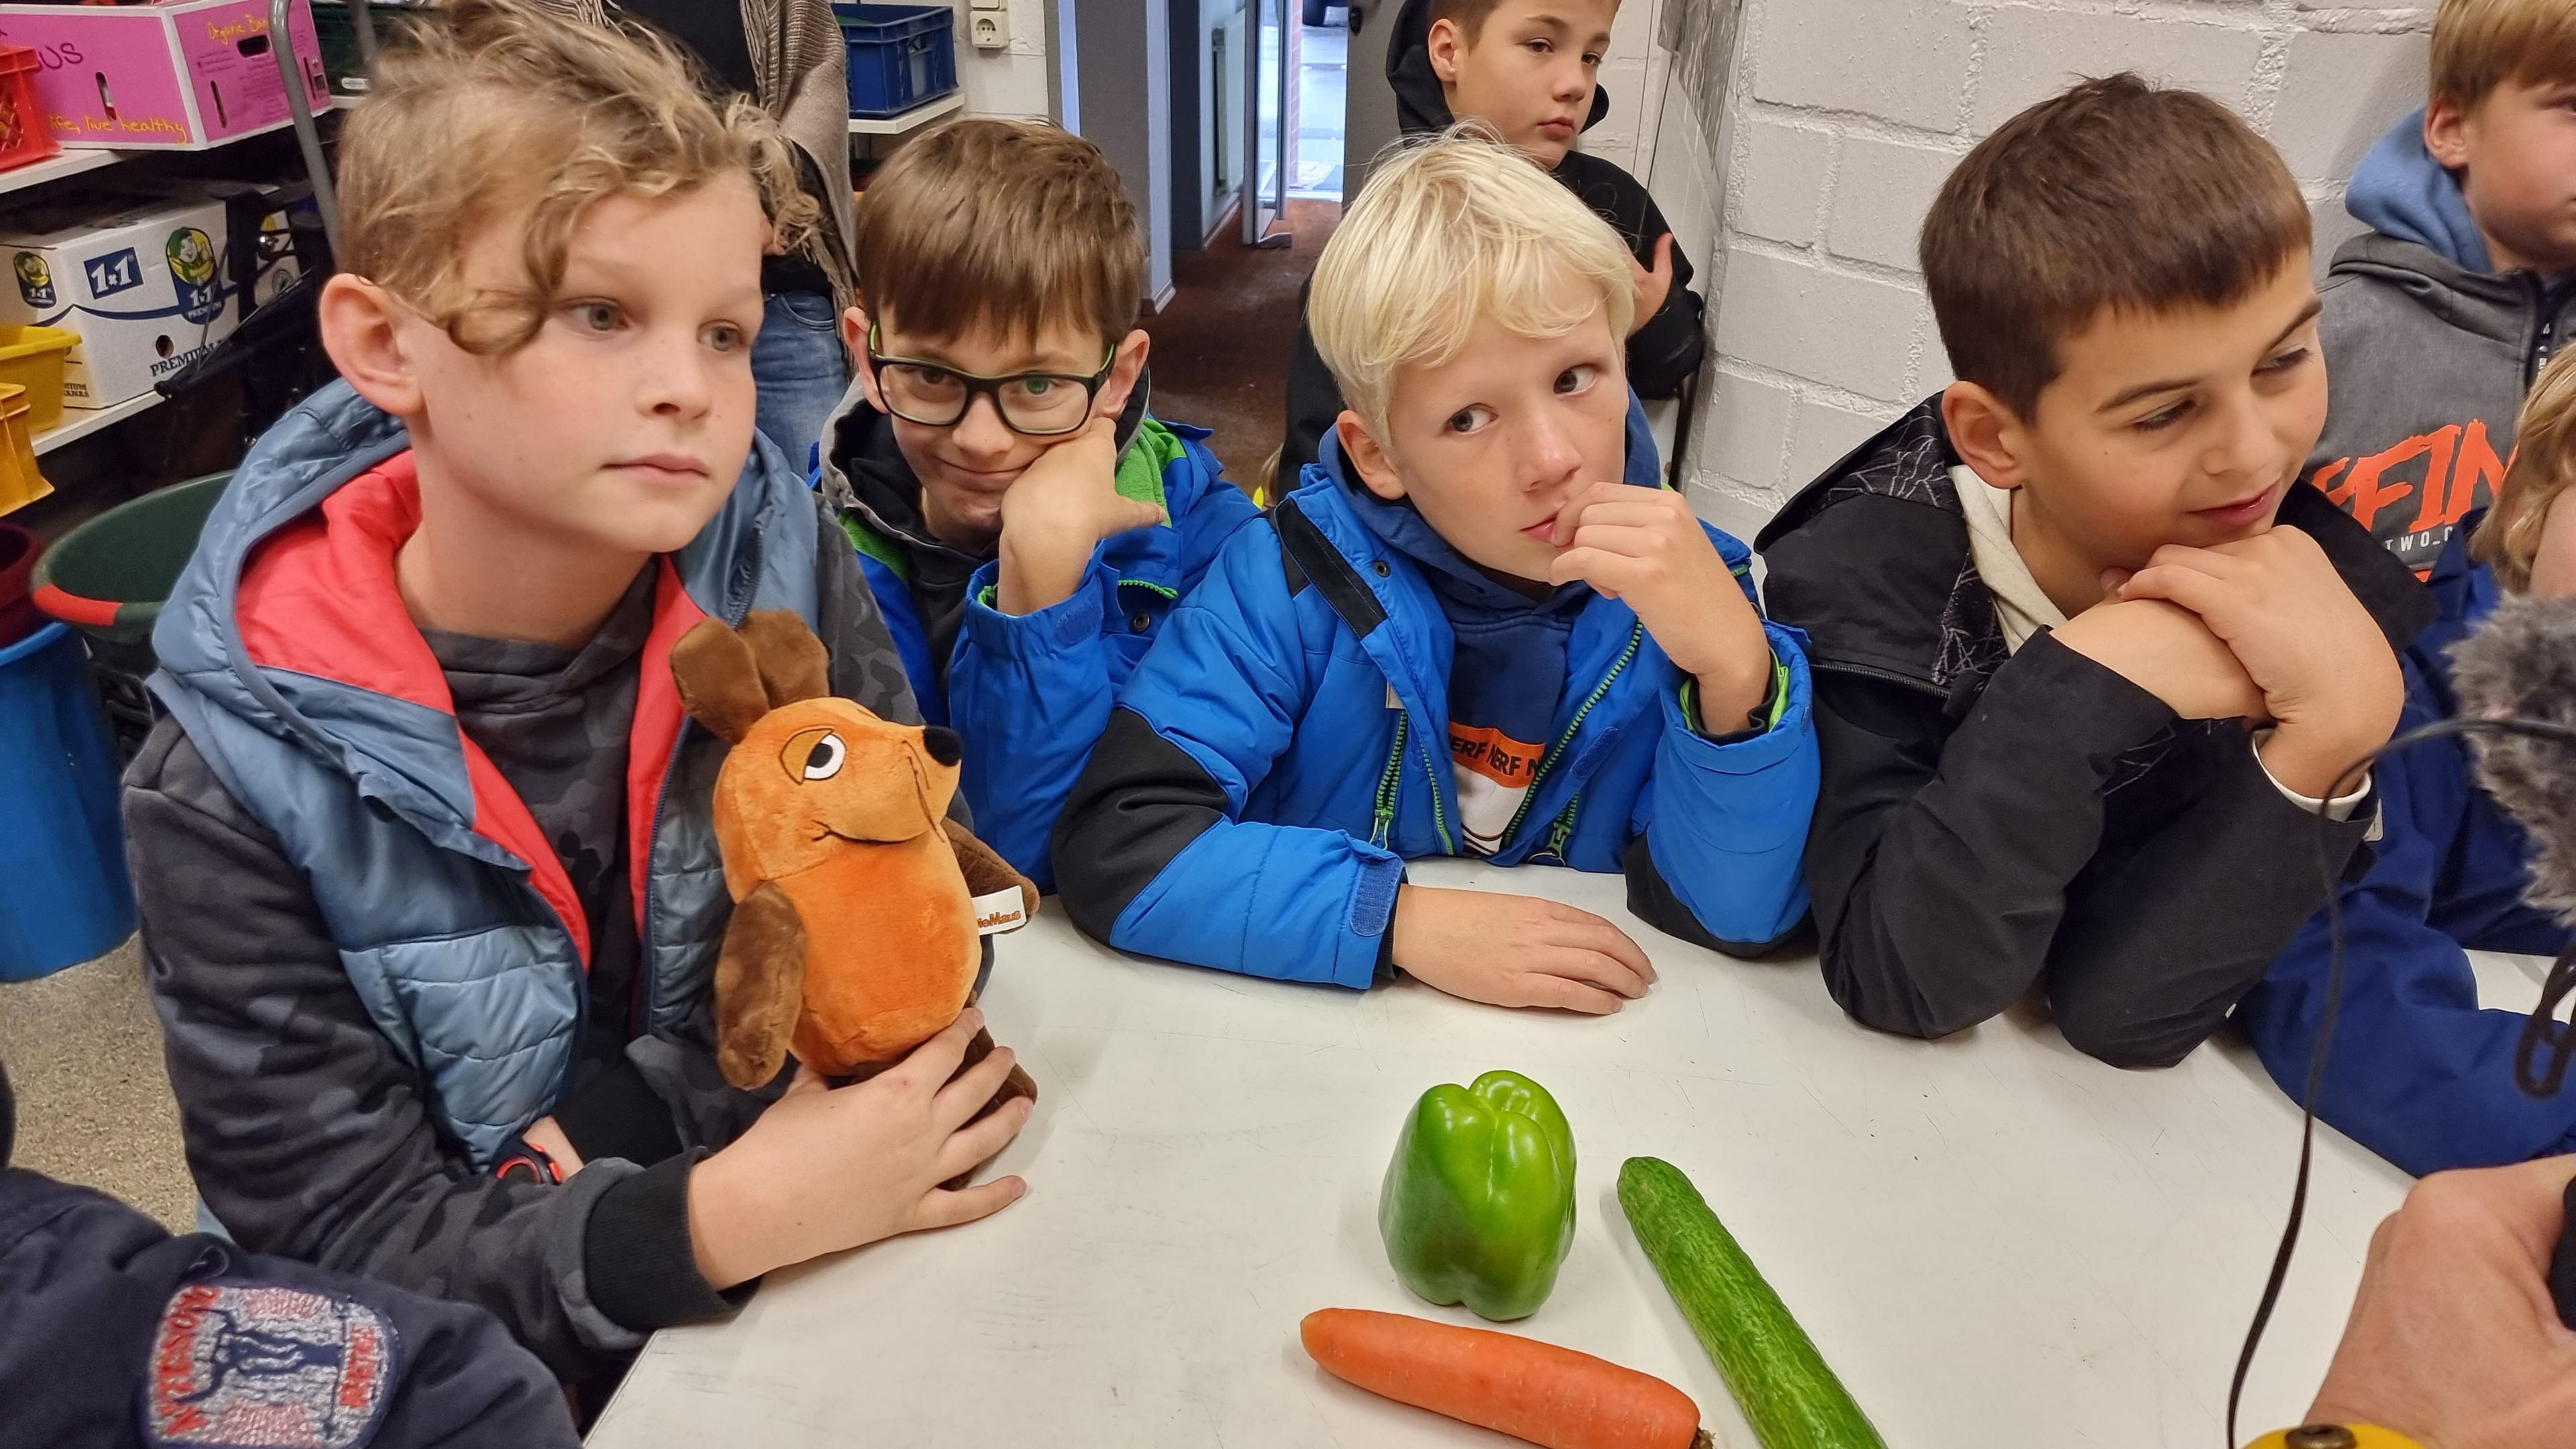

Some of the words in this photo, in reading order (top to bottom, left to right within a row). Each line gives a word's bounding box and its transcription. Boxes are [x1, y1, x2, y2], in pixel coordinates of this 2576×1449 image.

[85, 115, 113, 131] live
[117, 117, 189, 144] healthy
[1486, 743, 1522, 776] NERF
